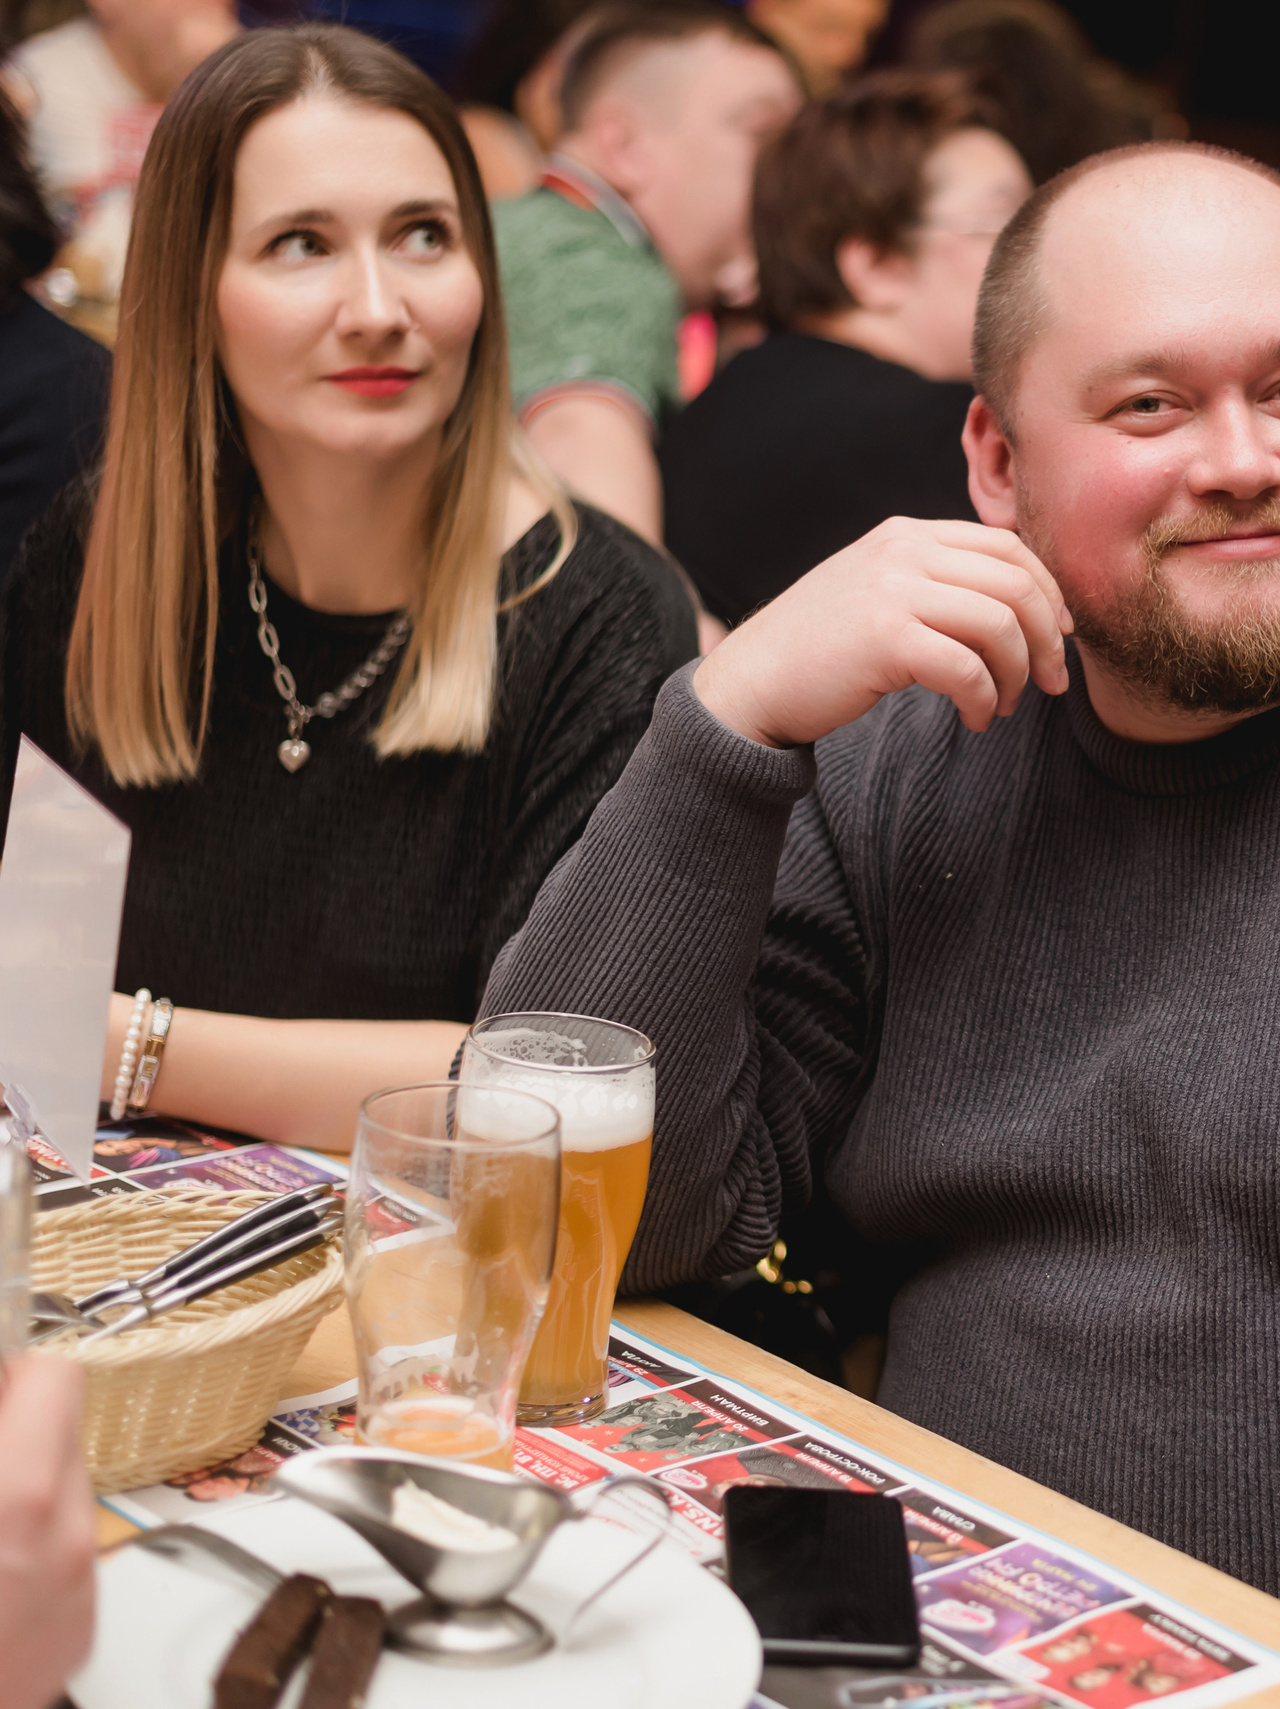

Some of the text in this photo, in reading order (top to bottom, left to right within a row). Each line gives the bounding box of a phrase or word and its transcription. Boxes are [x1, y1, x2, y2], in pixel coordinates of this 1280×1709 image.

[608, 1356, 649, 1376] 29 АПРЕ
[690, 1399, 749, 1433] 20 АПРЕЛЯ
[710, 1393, 770, 1427] БИРТМАН
[795, 1452, 839, 1478] АПРЕЛЯ
[803, 1441, 887, 1485] РОК-ОСТРОВА
[932, 1506, 976, 1531] СЛАВА
